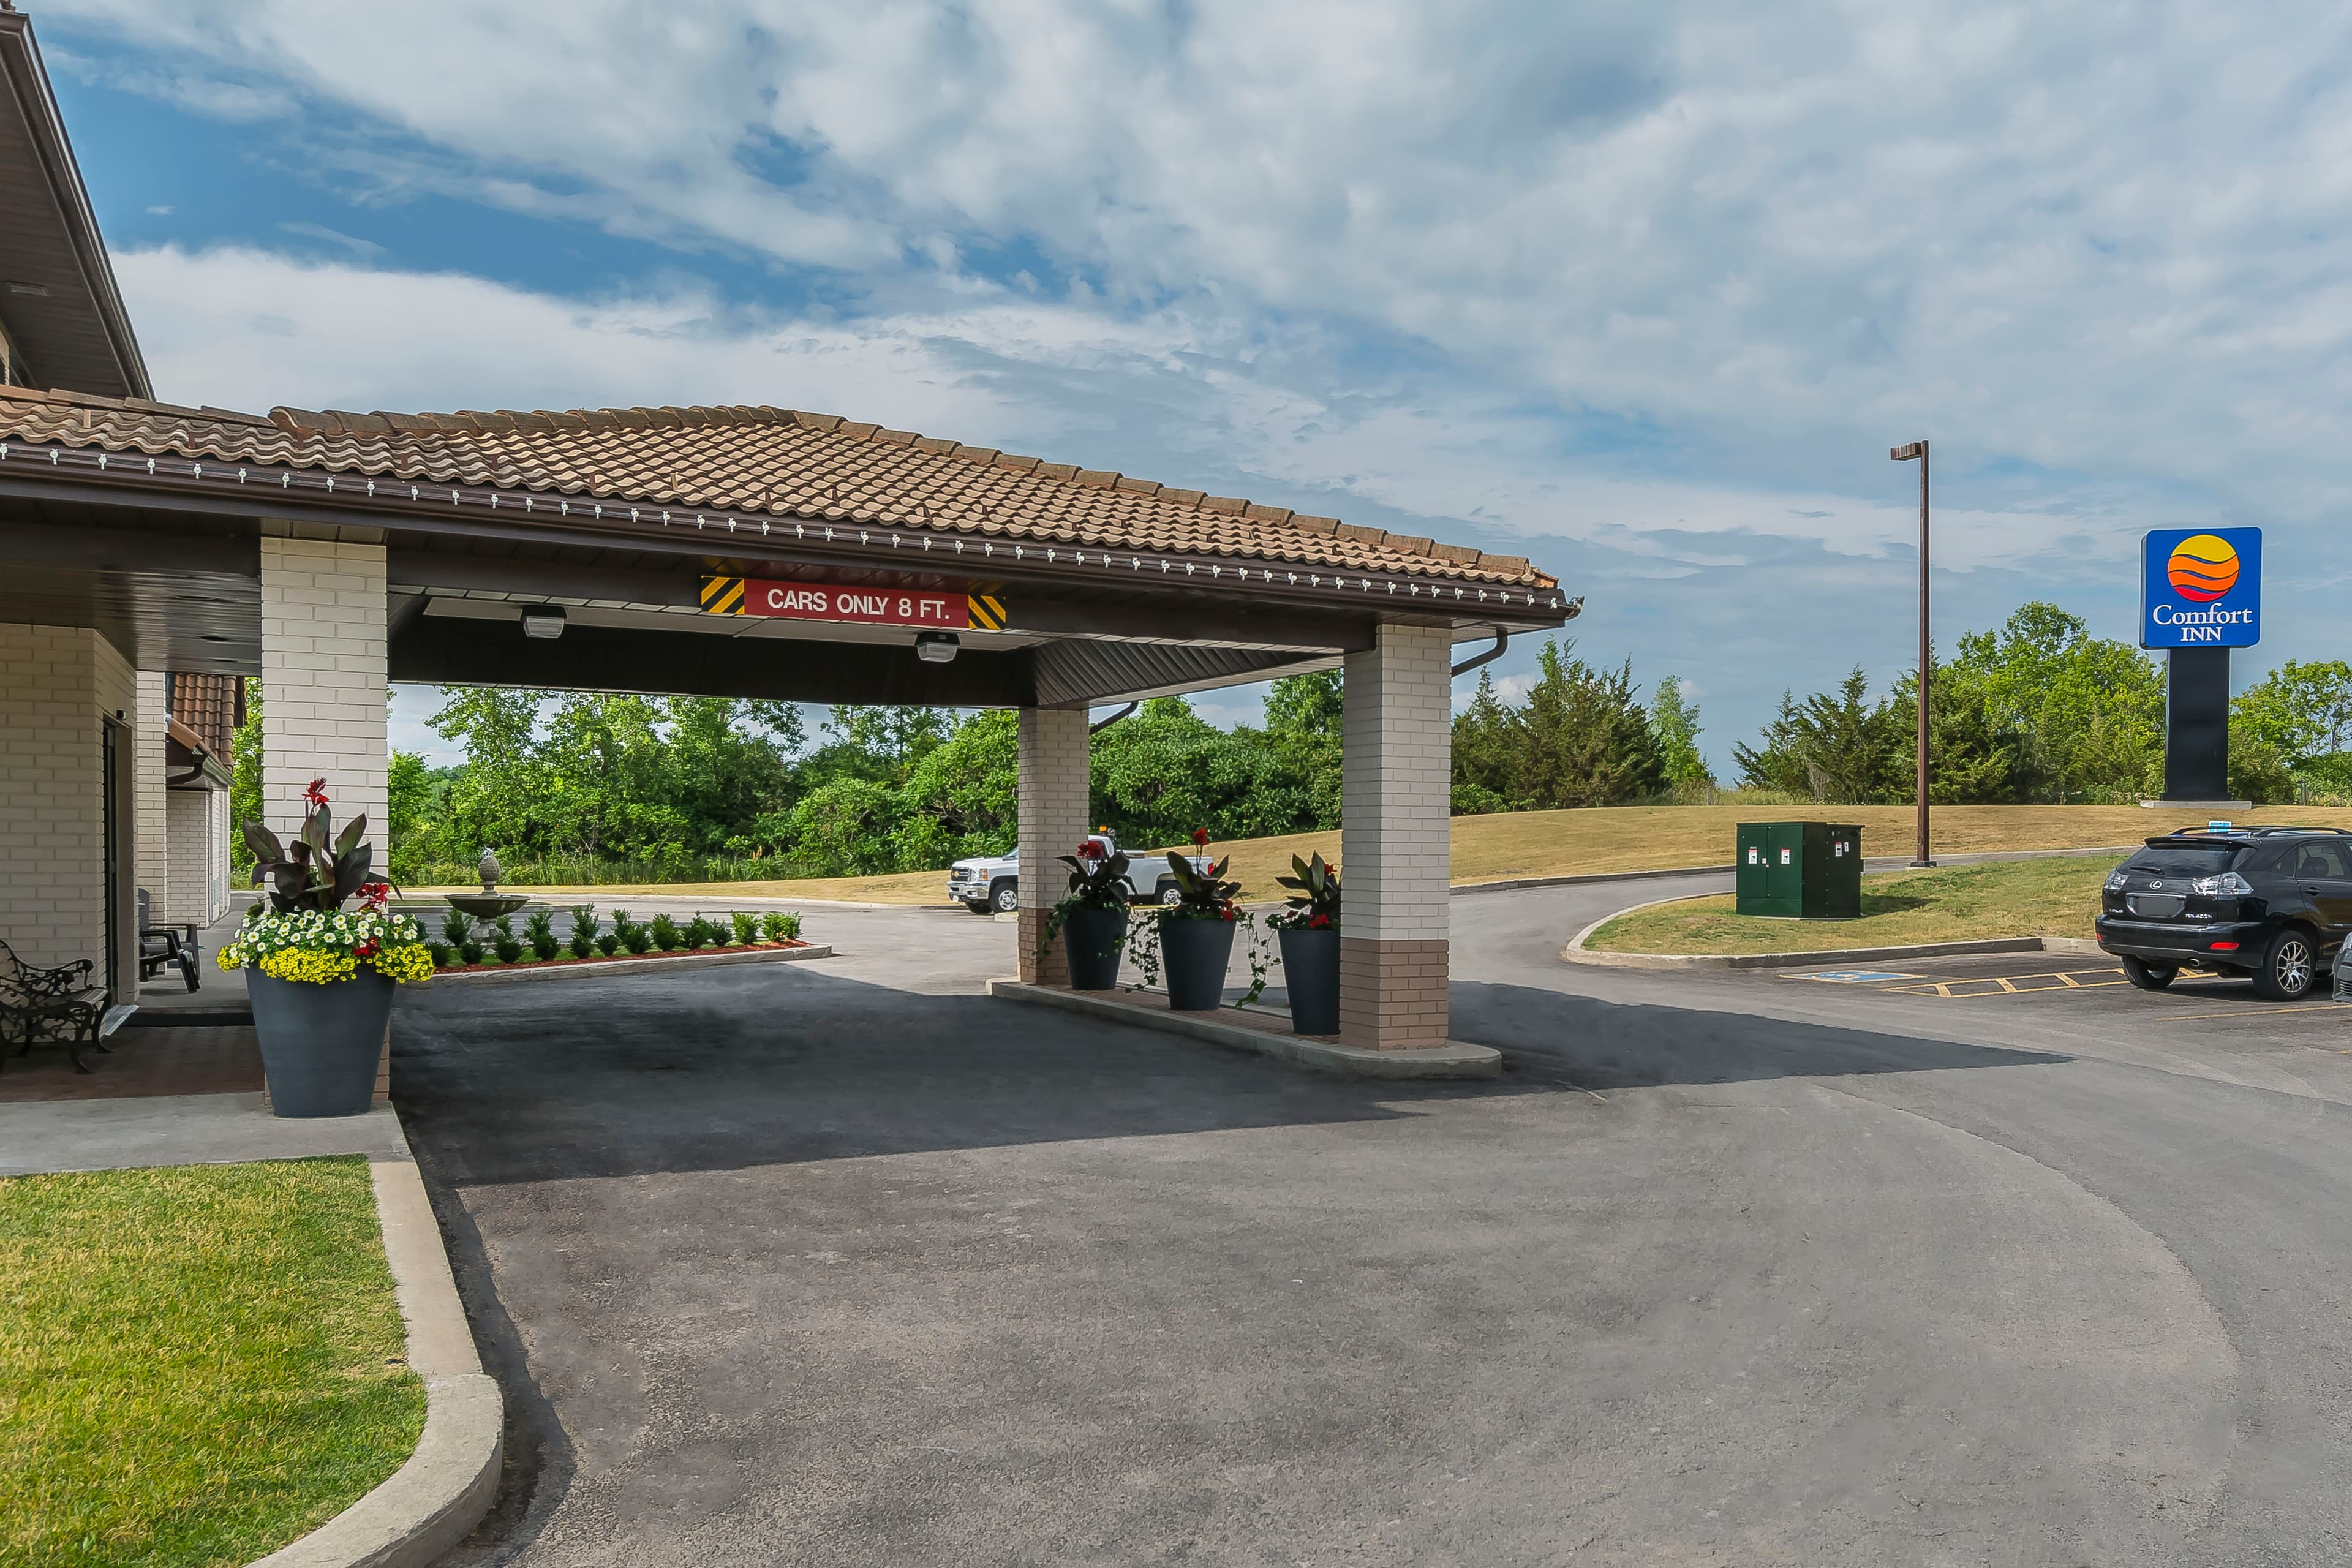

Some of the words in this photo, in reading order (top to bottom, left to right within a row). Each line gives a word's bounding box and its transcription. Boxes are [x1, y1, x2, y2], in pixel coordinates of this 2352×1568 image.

[767, 589, 827, 611] CARS
[837, 594, 889, 616] ONLY
[898, 598, 912, 617] 8
[919, 600, 949, 619] FT.
[2153, 602, 2252, 625] Comfort
[2180, 627, 2223, 641] INN
